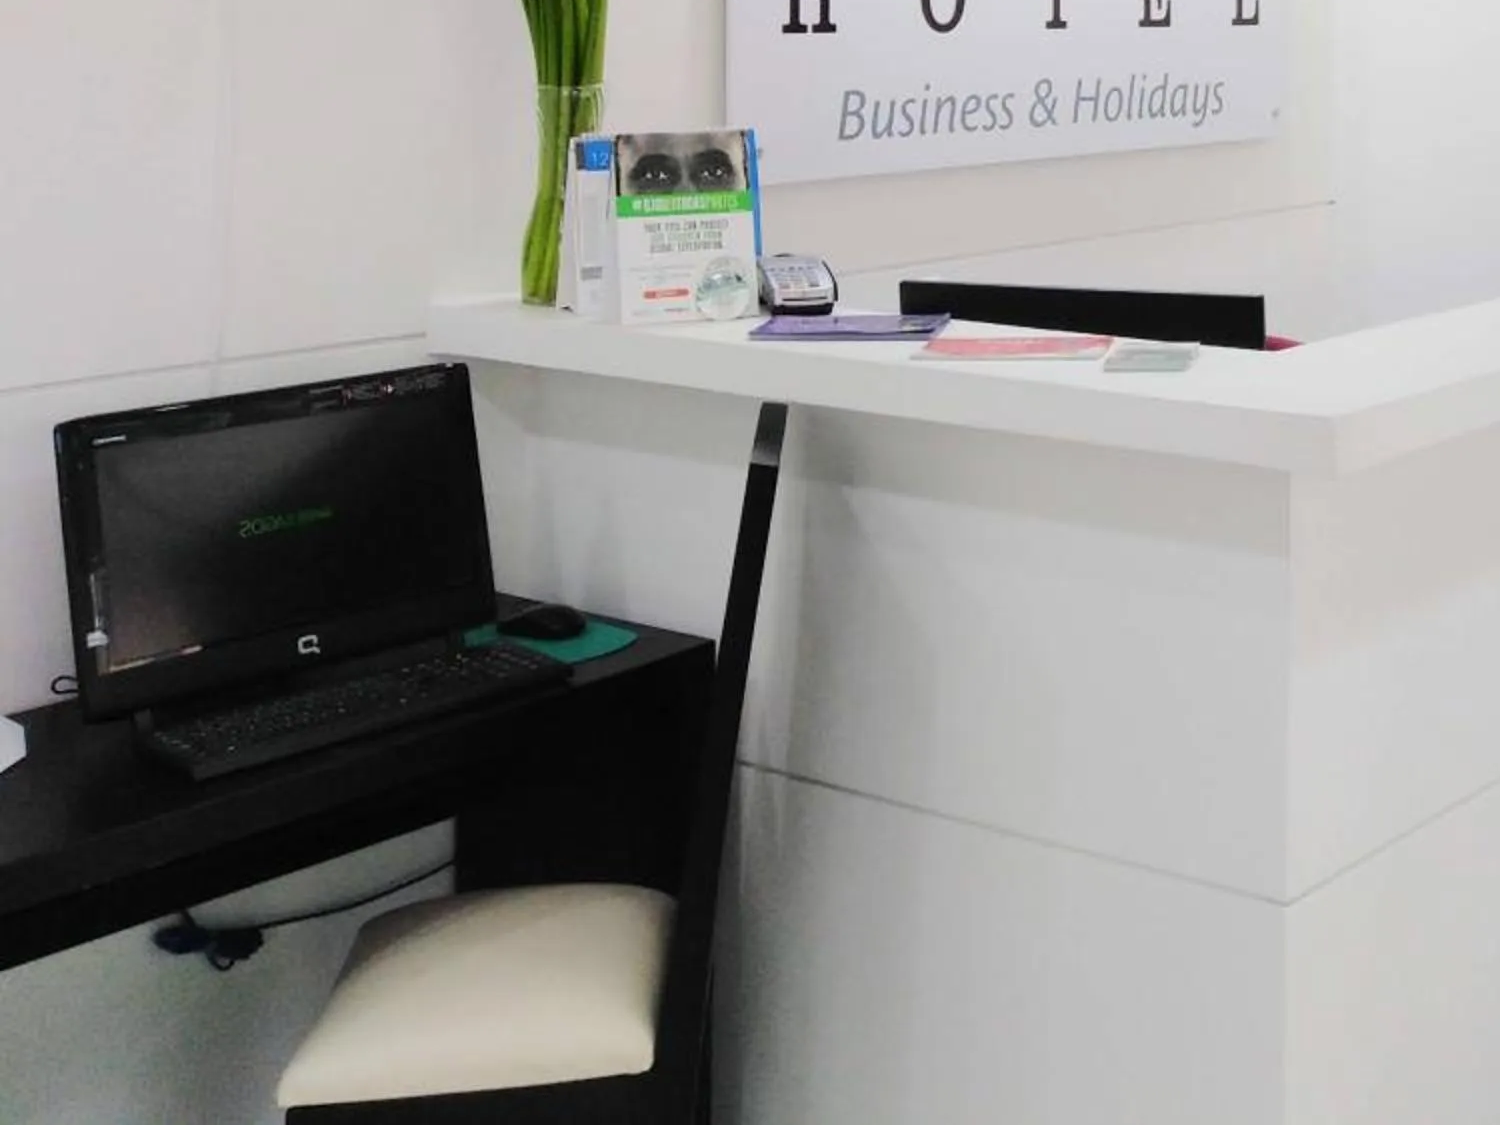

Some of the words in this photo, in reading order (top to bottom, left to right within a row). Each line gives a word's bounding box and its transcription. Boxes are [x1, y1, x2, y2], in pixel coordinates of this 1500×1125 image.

[836, 83, 1016, 142] Business
[1027, 78, 1059, 129] &
[1073, 73, 1226, 129] Holidays
